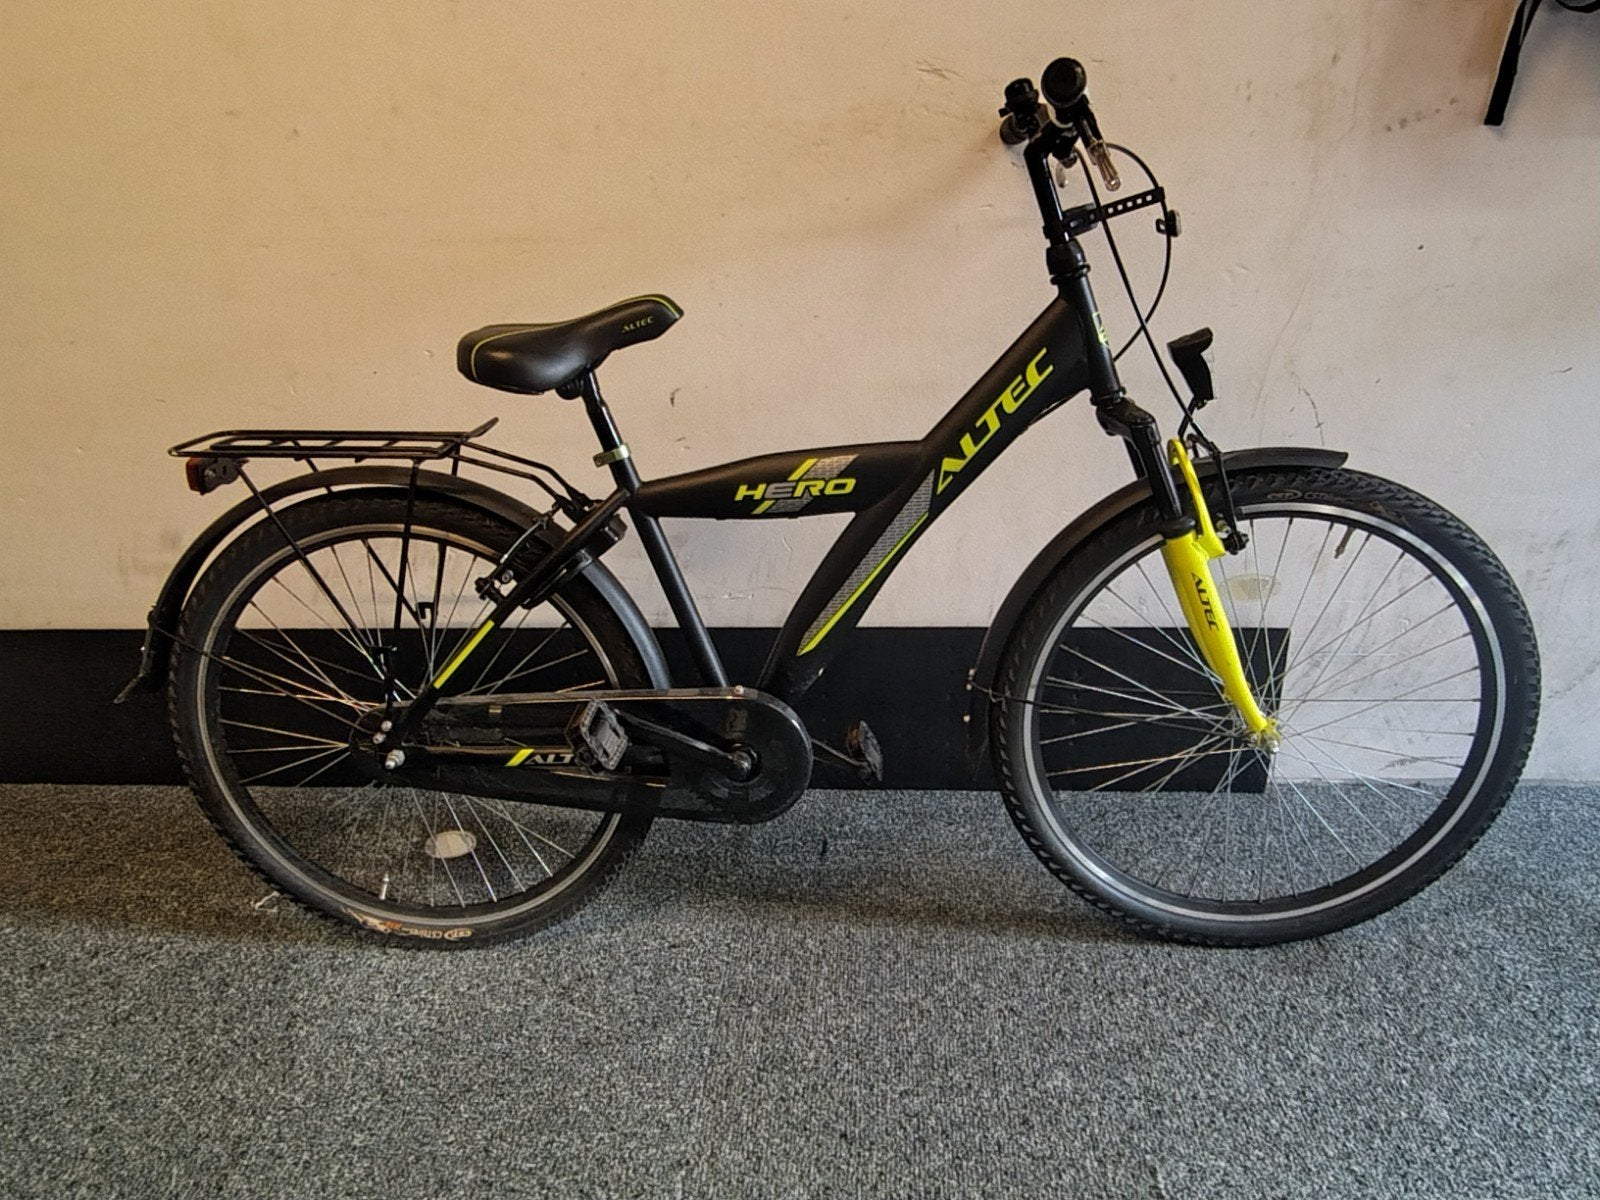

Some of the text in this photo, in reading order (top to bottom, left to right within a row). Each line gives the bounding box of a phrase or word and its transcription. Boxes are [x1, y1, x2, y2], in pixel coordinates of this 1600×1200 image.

[621, 316, 654, 333] ALTEC
[936, 347, 1054, 495] ALTEC
[734, 478, 857, 501] HERO
[1191, 572, 1220, 632] ALTEC
[524, 754, 575, 765] ALT
